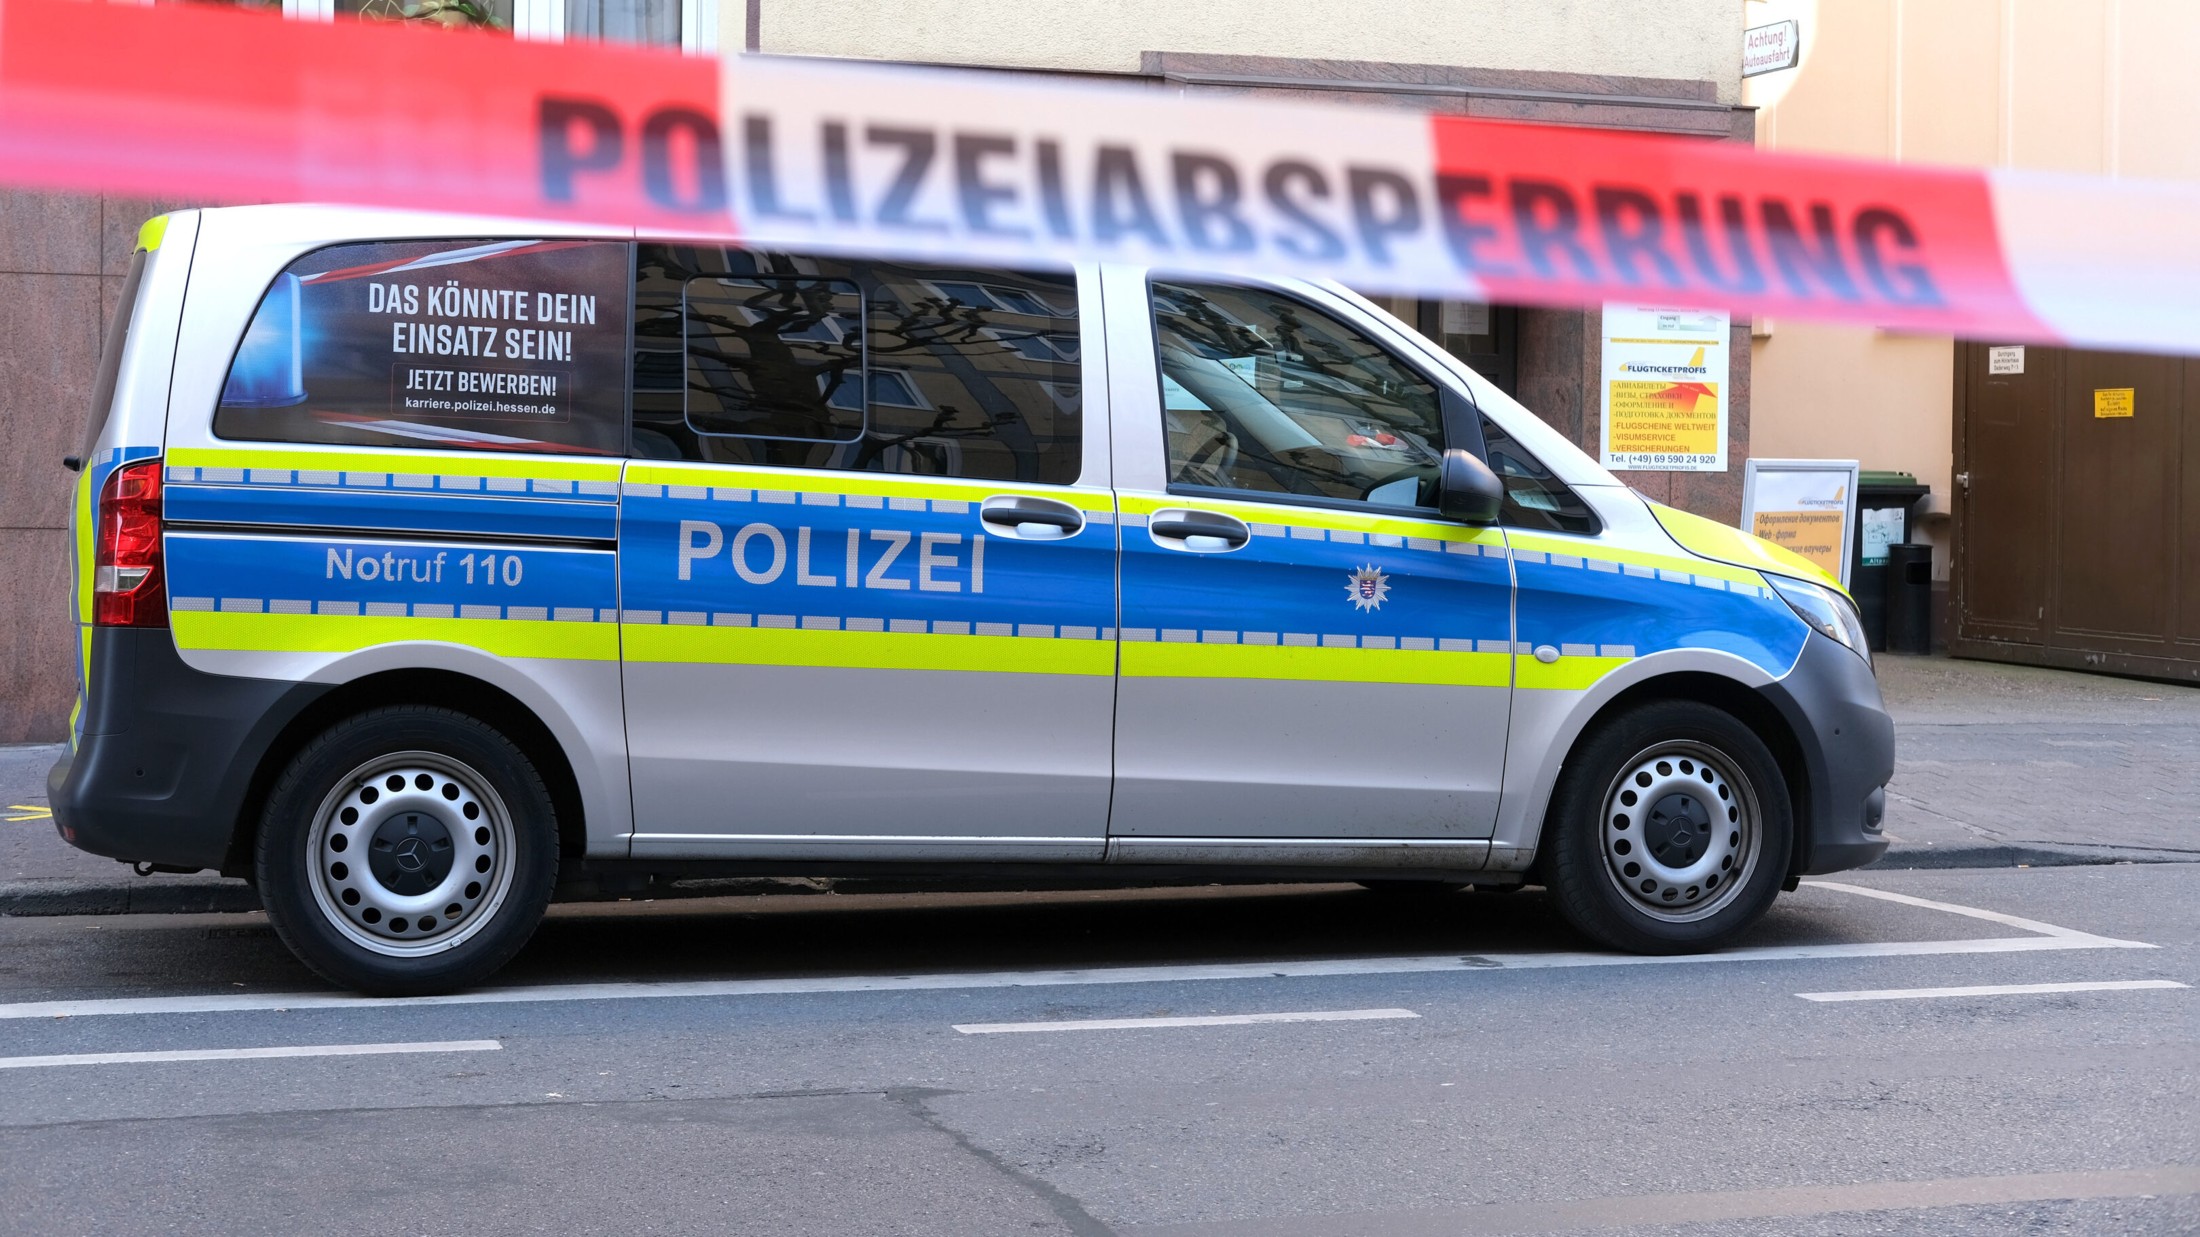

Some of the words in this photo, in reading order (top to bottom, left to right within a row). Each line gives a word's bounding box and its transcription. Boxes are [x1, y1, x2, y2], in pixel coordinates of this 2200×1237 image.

[1747, 25, 1787, 50] Achtung!
[1744, 46, 1790, 68] Autoausfahrt
[536, 93, 1949, 308] POLIZEIABSPERRUNG
[368, 282, 419, 315] DAS
[427, 280, 529, 321] KÖNNTE
[537, 292, 596, 325] DEIN
[393, 322, 498, 358] EINSATZ
[505, 328, 572, 361] SEIN!
[1627, 365, 1707, 374] FLUGTICKETPROFIS
[406, 369, 454, 391] JETZT
[458, 372, 557, 396] BEWERBEN!
[405, 397, 556, 415] karriere.polizei.hessen.de
[1666, 412, 1717, 420] ДОКУМЕНТОВ
[1674, 423, 1715, 431] WELTWEIT
[1610, 454, 1626, 463] Tel.
[1628, 454, 1652, 465] (+49)
[1654, 455, 1665, 463] 69
[1667, 455, 1684, 464] 590
[1686, 455, 1697, 464] 24
[1699, 455, 1716, 464] 920
[1759, 514, 1799, 525] Оформление
[1799, 513, 1840, 525] документов
[1758, 529, 1773, 539] Web
[1775, 529, 1797, 541] форма
[678, 519, 986, 594] POLIZEI
[1803, 545, 1832, 555] ваучеры
[325, 547, 447, 584] Notruf
[459, 553, 523, 586] 110
